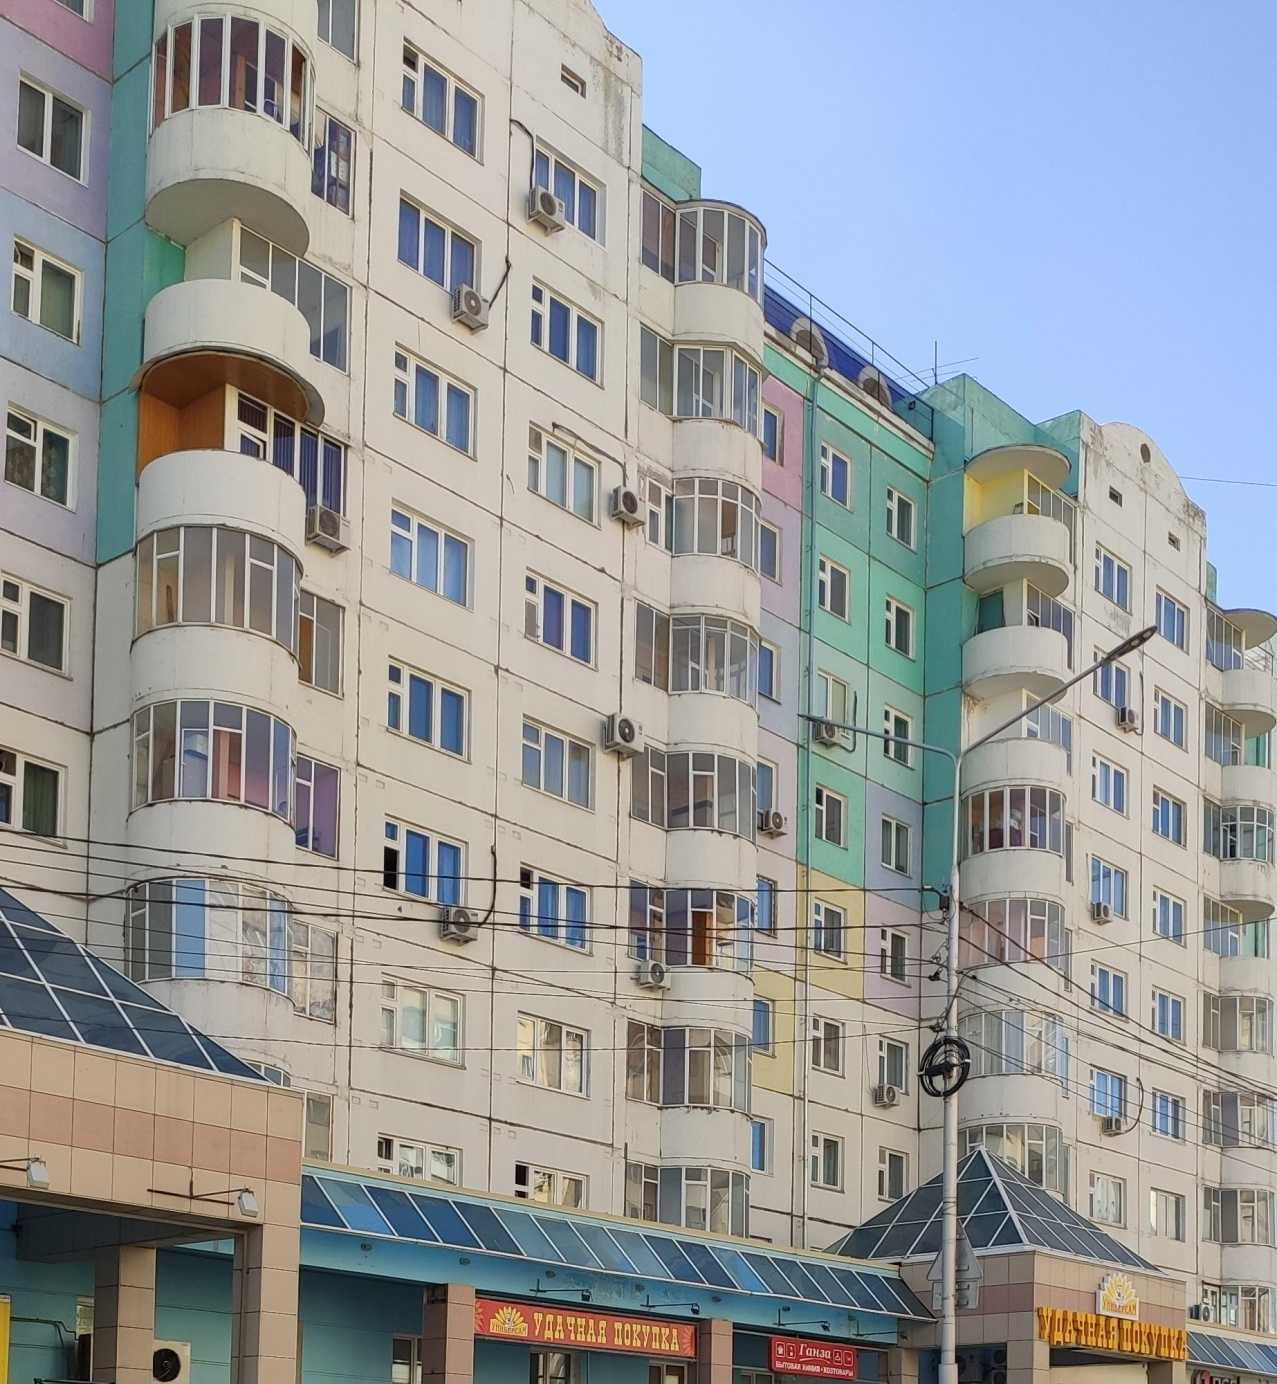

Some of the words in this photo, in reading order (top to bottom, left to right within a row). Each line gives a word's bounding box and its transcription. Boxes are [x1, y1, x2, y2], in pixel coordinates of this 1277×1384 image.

[533, 1312, 607, 1344] УДАЧНАЯ
[614, 1322, 680, 1351] ПОКУПКА
[799, 1343, 832, 1359] Ганза
[1038, 1306, 1119, 1349] УДАЧНАЯ
[1119, 1320, 1187, 1361] ПОКУПКА
